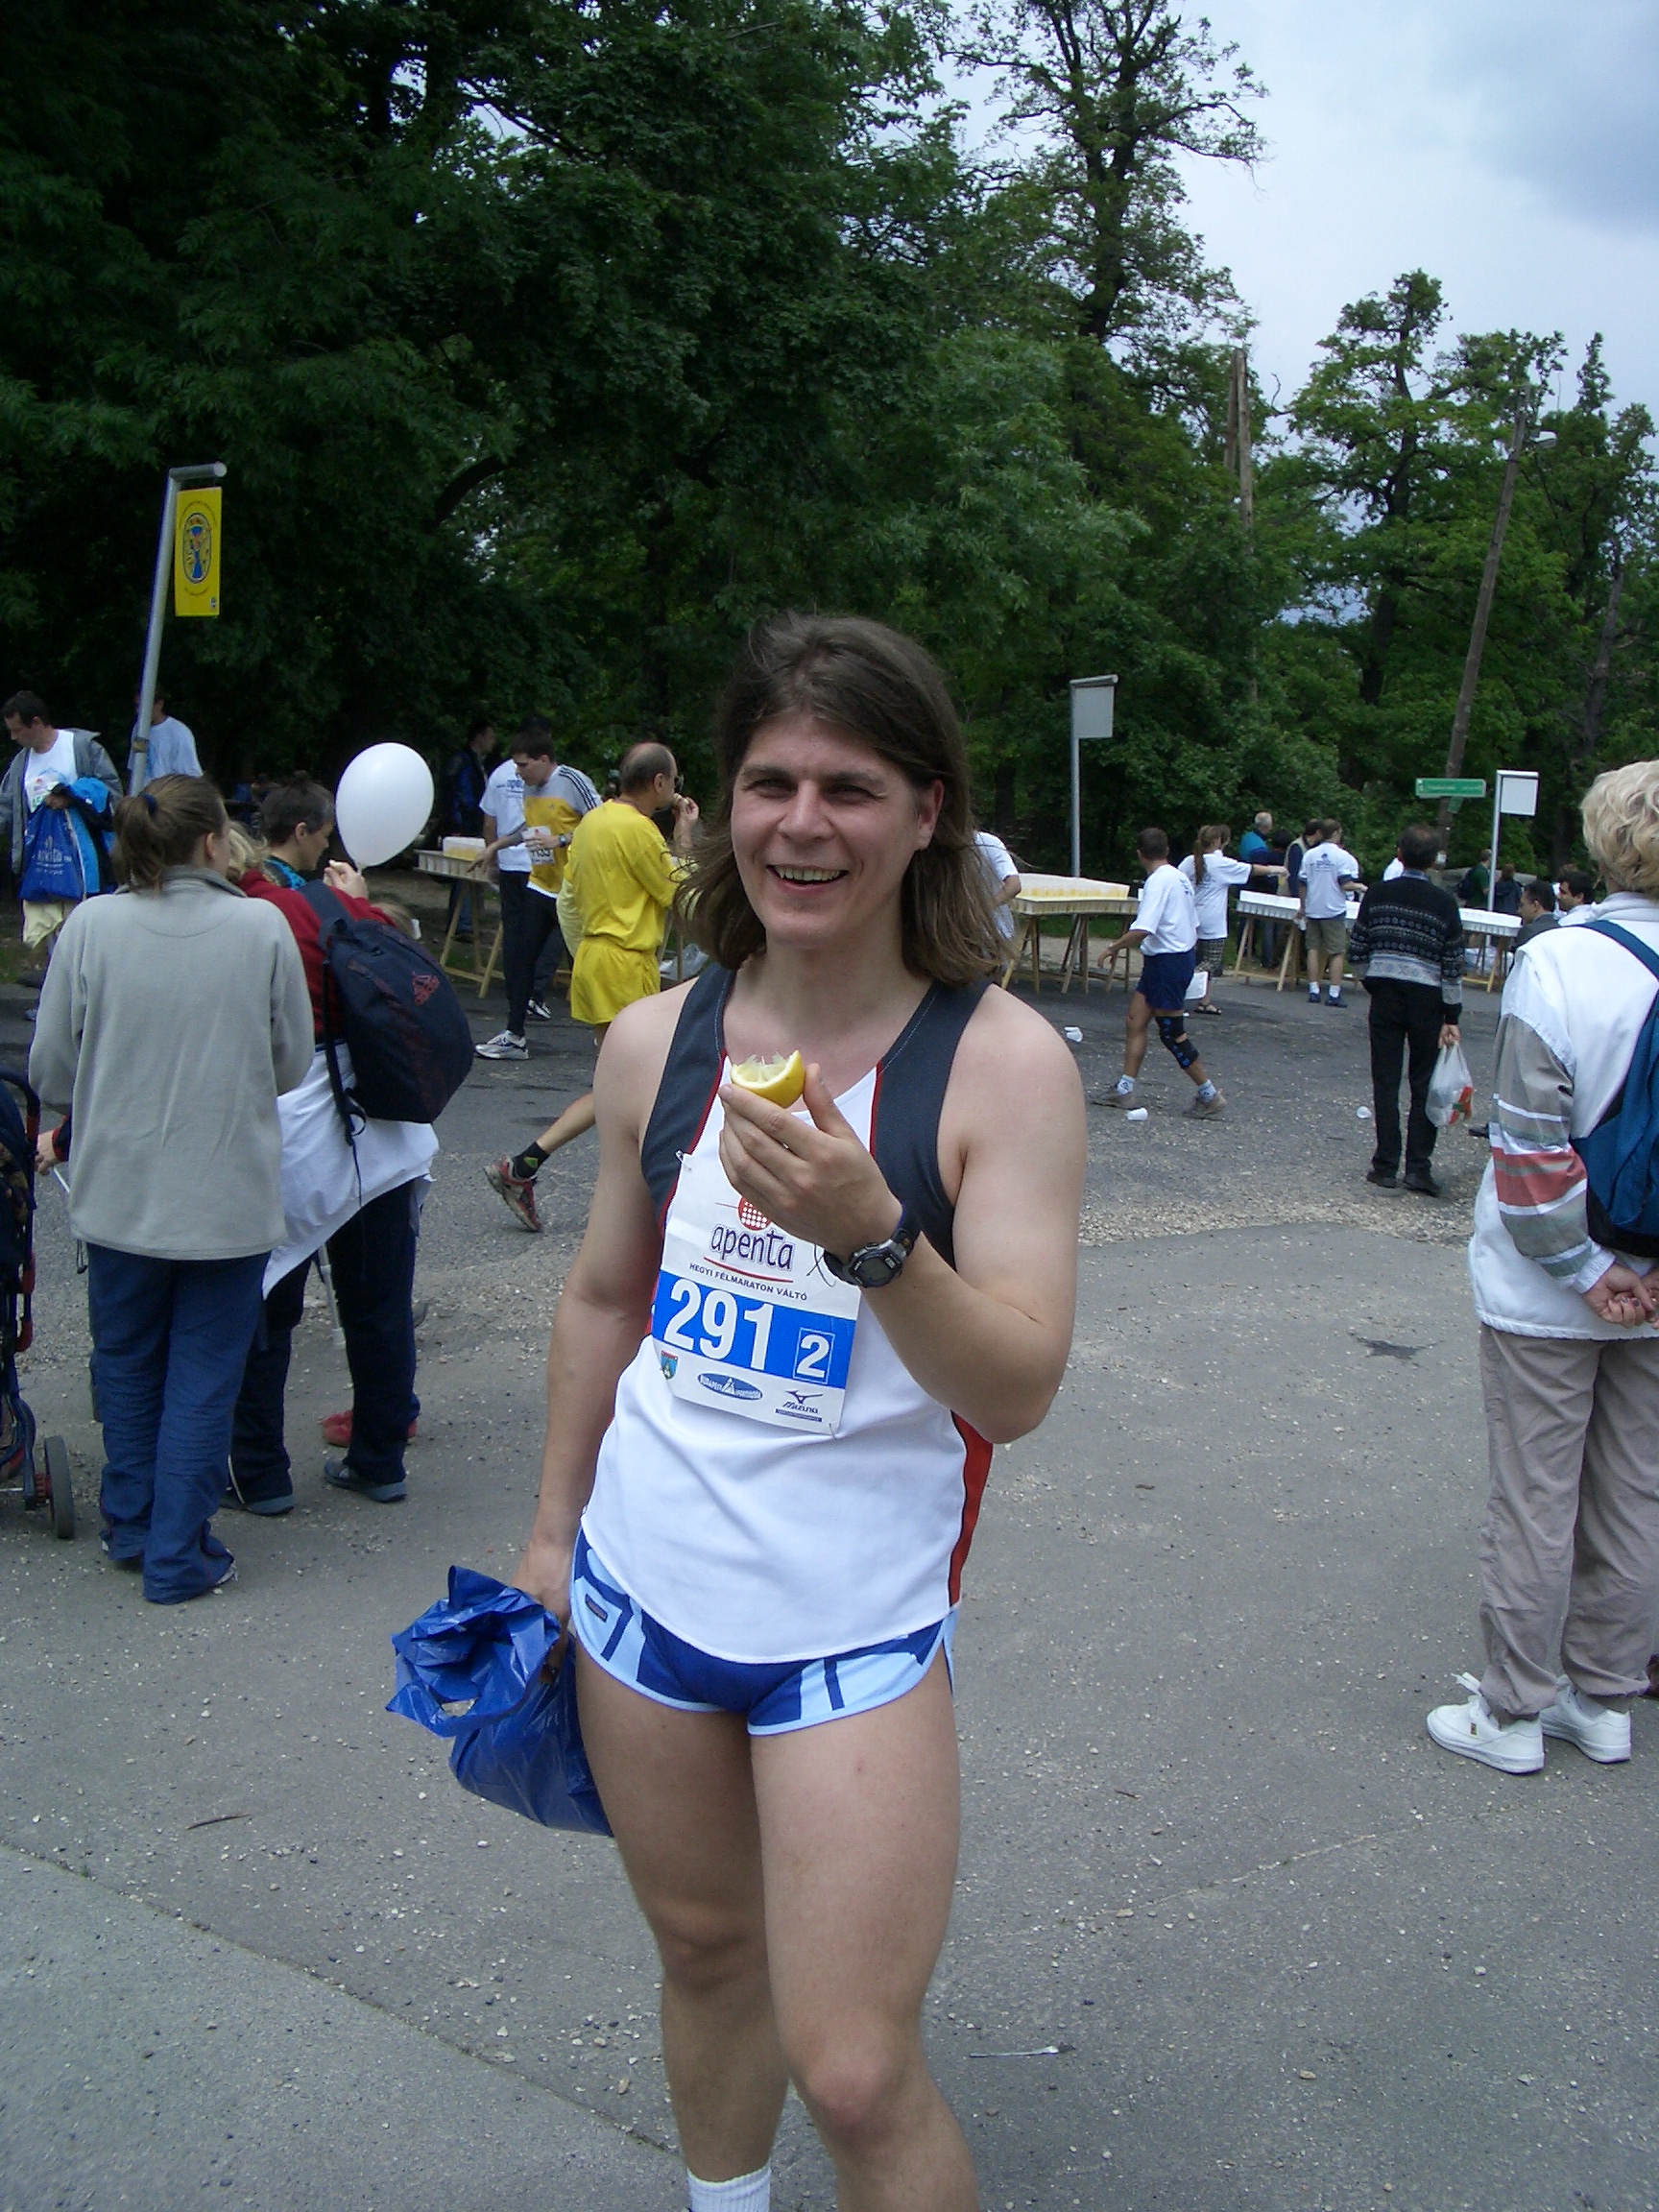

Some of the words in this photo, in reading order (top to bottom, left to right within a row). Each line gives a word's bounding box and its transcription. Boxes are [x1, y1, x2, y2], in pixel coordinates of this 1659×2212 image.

[710, 1223, 794, 1271] apenta
[689, 1262, 713, 1277] HEGYI
[714, 1271, 775, 1293] FÉLMARATON
[776, 1287, 808, 1301] VÁLTÓ
[663, 1278, 774, 1372] 291
[796, 1334, 830, 1380] 2
